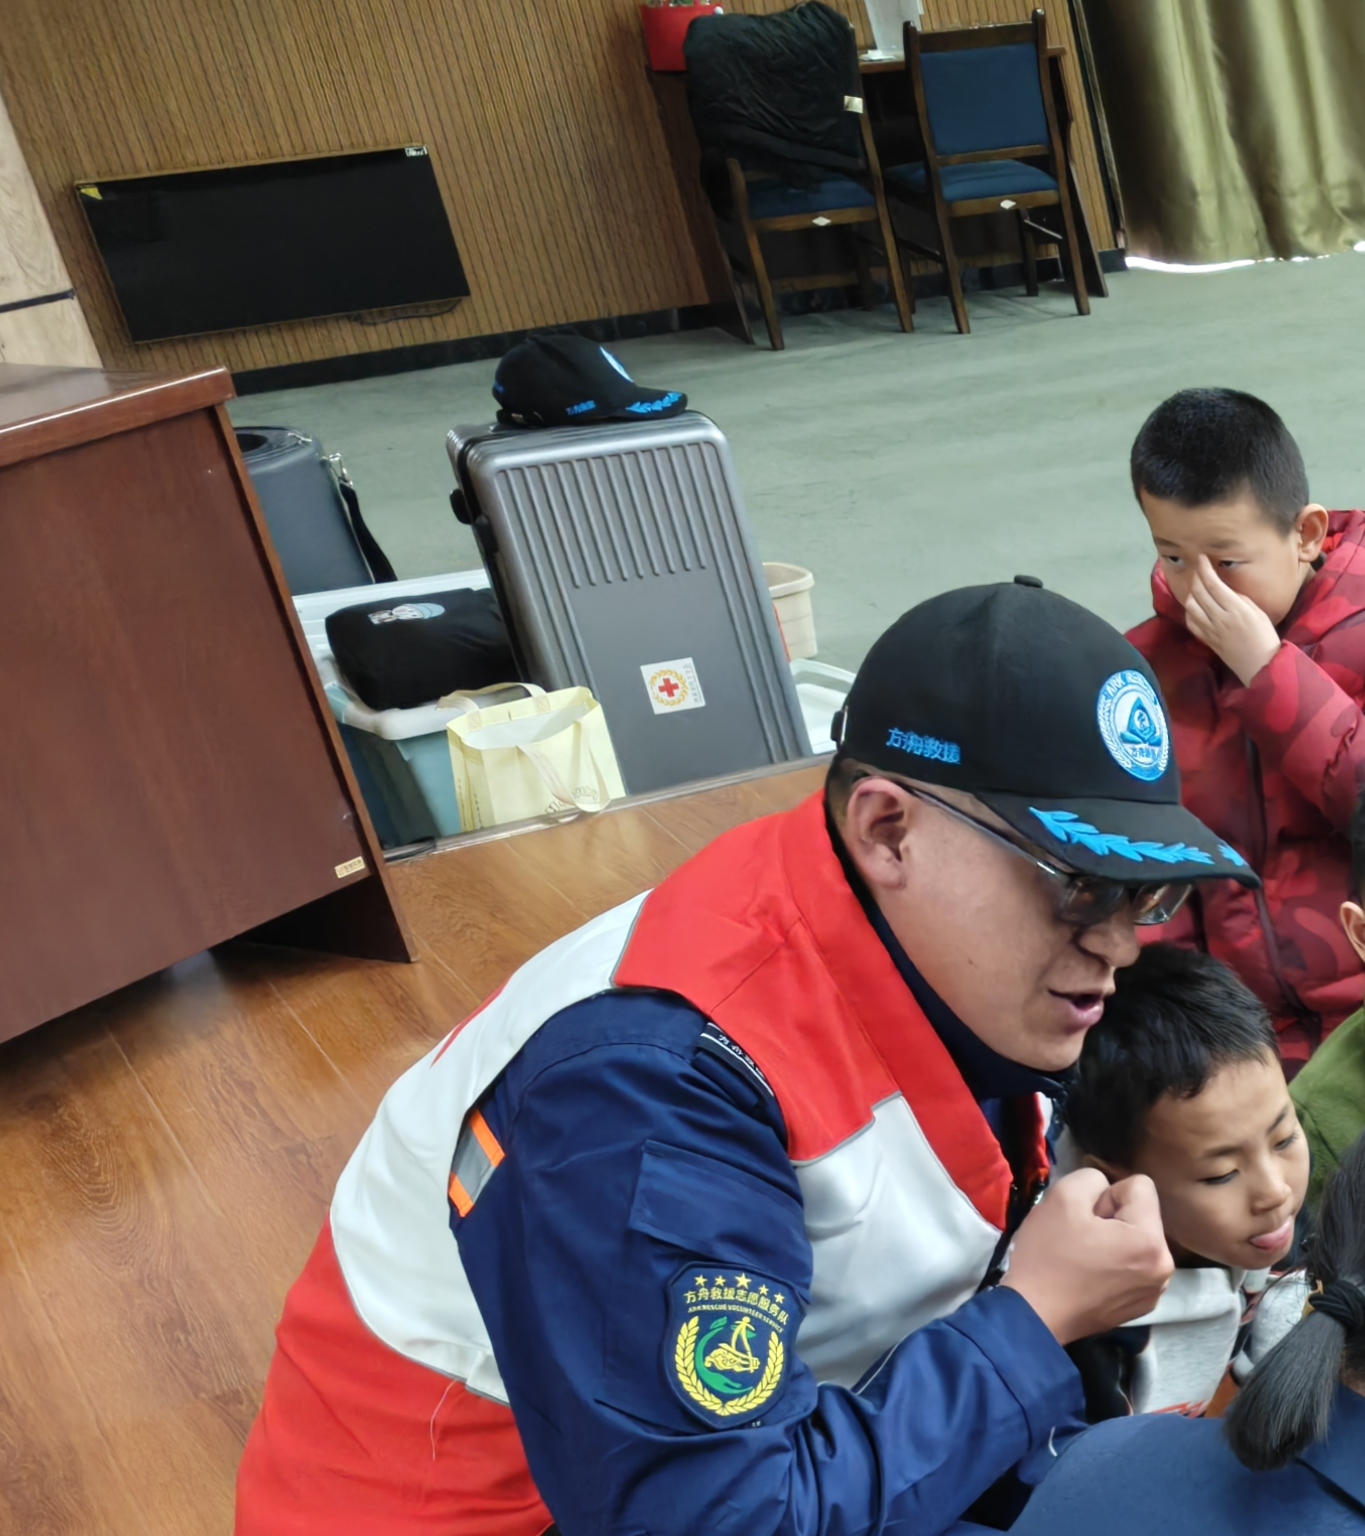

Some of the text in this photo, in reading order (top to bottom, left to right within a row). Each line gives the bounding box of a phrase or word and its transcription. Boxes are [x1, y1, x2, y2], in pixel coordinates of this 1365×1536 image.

[683, 1286, 789, 1325] 方舟救援志愿服务队
